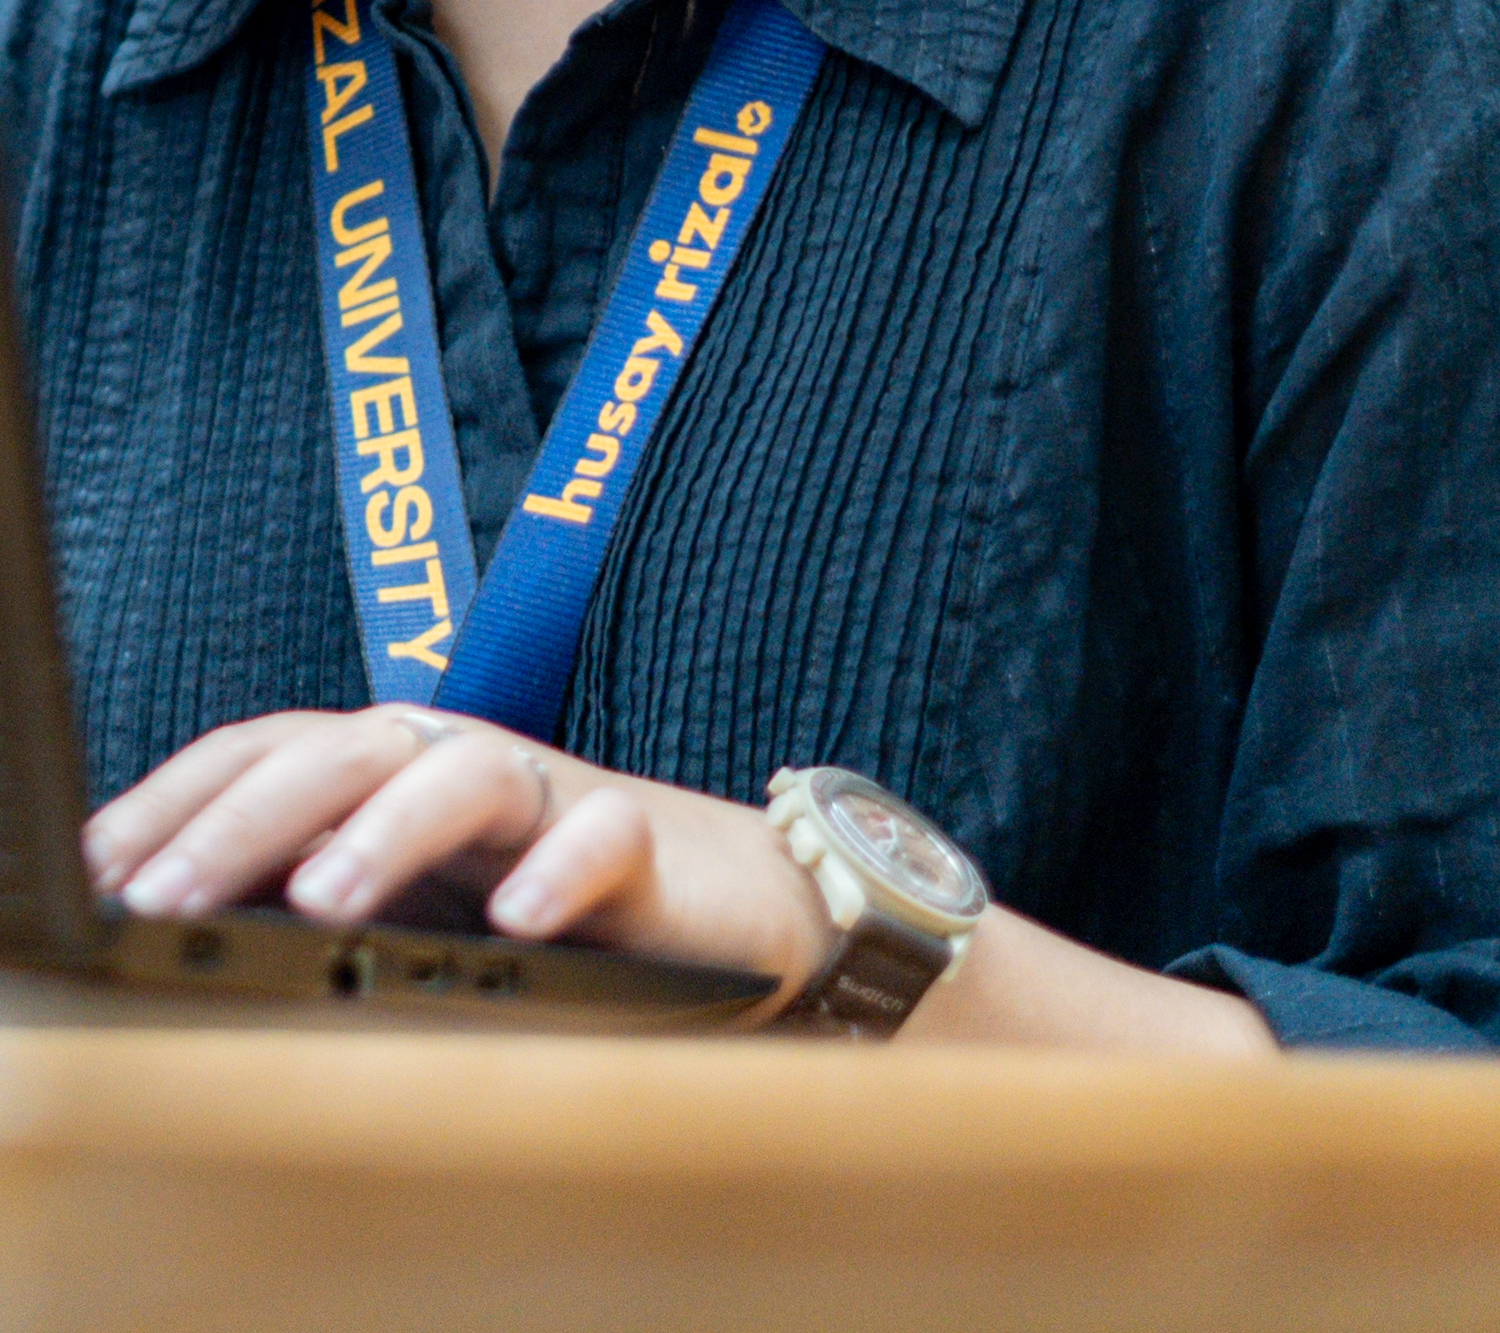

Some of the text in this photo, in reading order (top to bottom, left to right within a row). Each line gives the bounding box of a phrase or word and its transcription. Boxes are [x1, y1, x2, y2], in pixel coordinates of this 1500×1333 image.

[329, 179, 453, 671] UNIVERSITY
[523, 126, 760, 524] husay rizal
